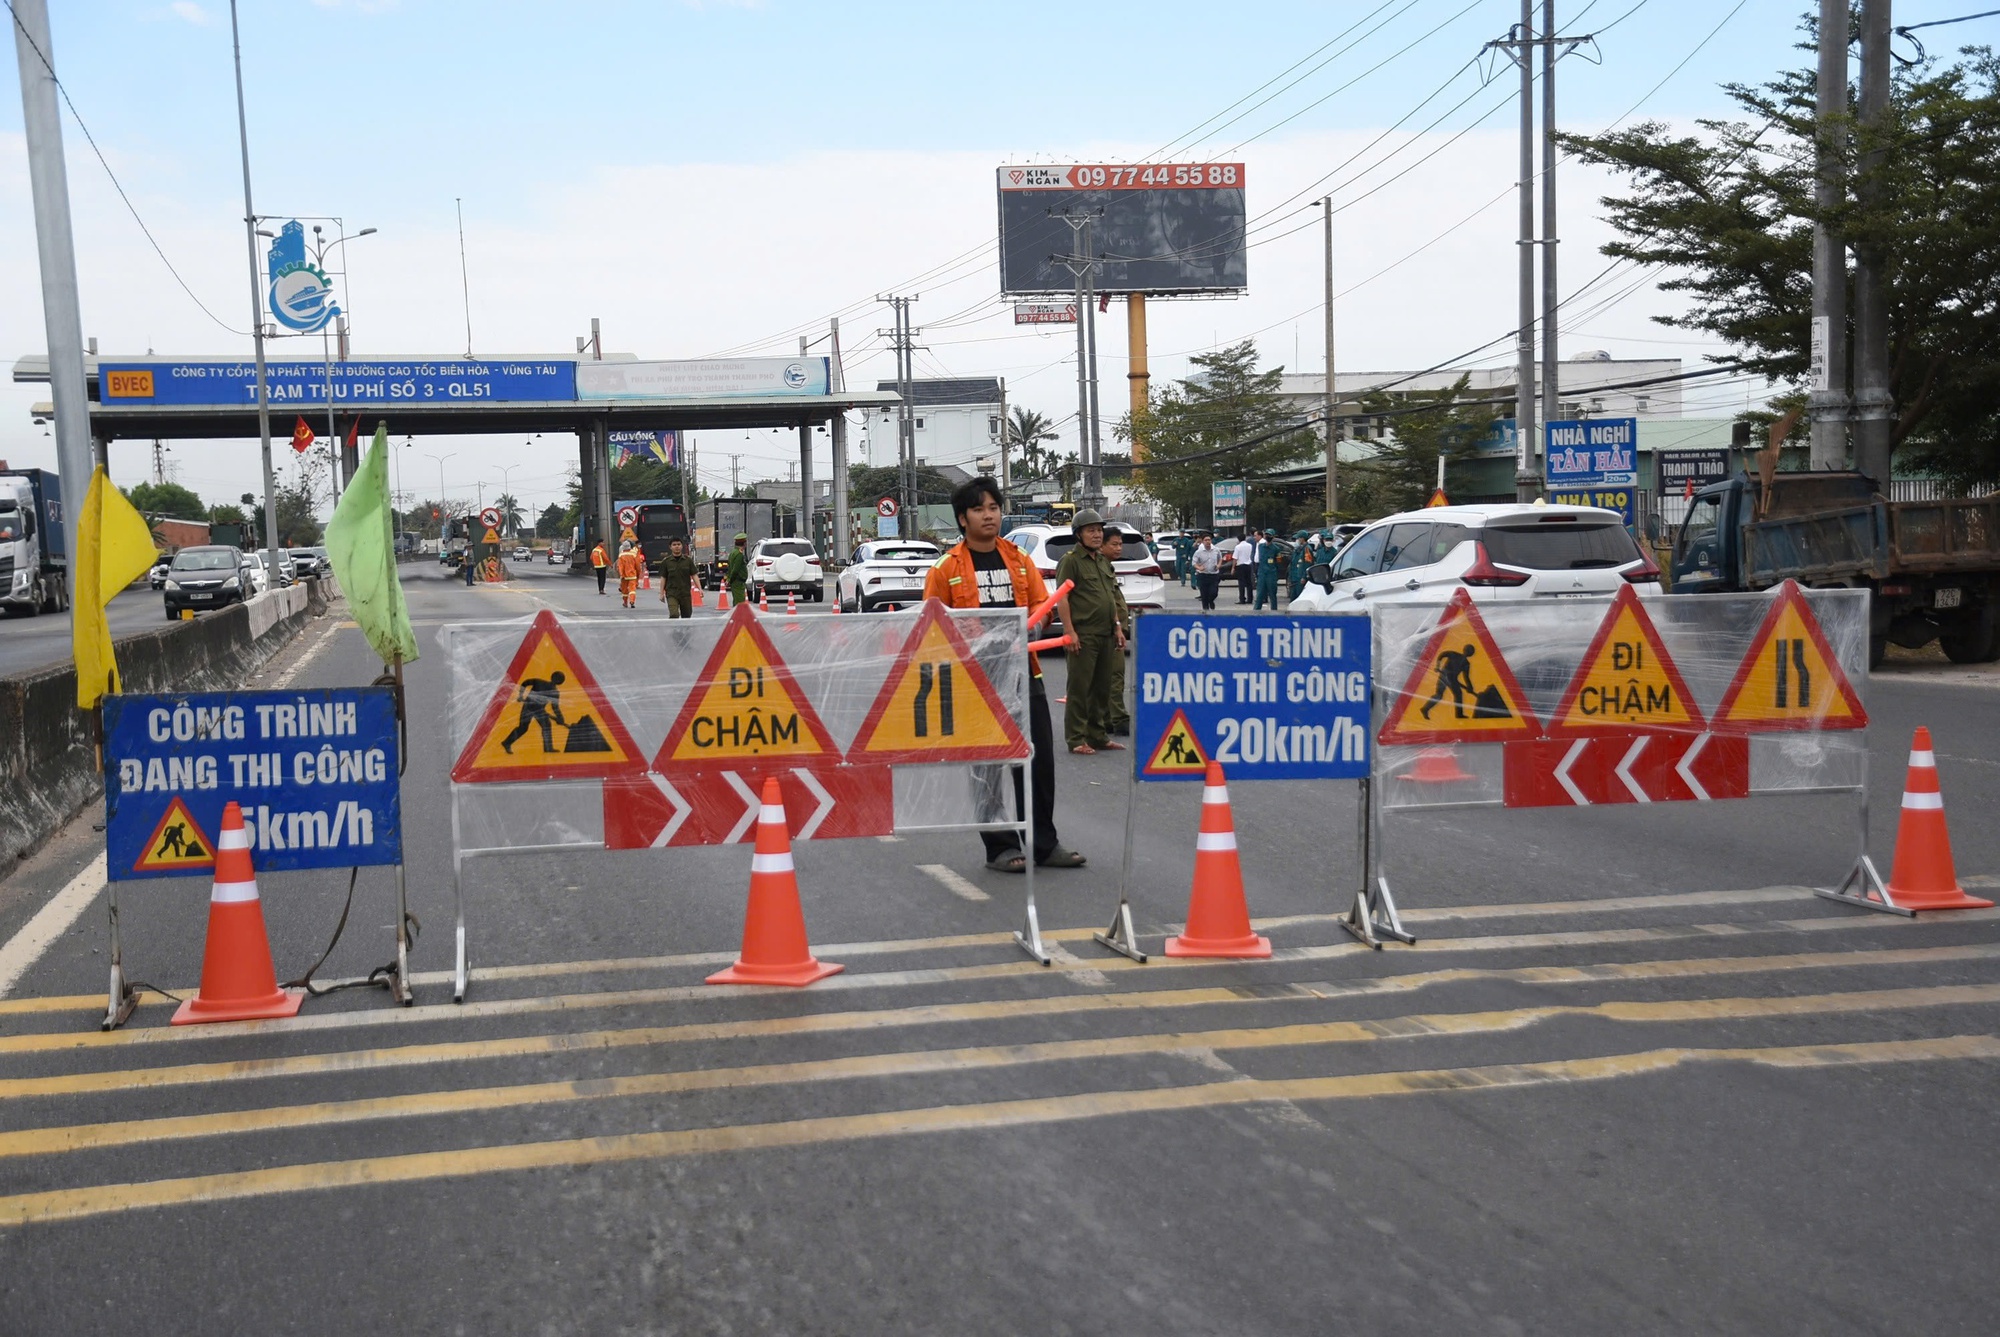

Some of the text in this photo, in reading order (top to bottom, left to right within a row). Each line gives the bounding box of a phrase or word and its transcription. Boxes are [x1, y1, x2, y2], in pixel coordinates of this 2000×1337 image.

[1077, 167, 1106, 186] 09
[1175, 166, 1203, 185] 55
[1208, 166, 1236, 185] 88
[111, 376, 150, 392] BVEC
[173, 366, 206, 377] CÔNG
[209, 367, 224, 377] TY
[226, 363, 243, 377] CỔ
[244, 366, 276, 377] PHN
[277, 364, 307, 377] PHÁT
[347, 363, 385, 376] ĐƯỜNG
[389, 366, 411, 376] CAO
[415, 363, 437, 376] TỐC
[467, 363, 490, 376] HÒA
[502, 364, 532, 375] VŨNG
[535, 364, 557, 375] TÀU
[308, 383, 347, 398] THU
[353, 379, 384, 397] PHÍ
[390, 378, 416, 398] SỐ
[424, 383, 434, 397] 3
[448, 382, 492, 398] QL51
[1551, 420, 1630, 446] NHÀ NGHỈ
[1549, 447, 1591, 473] TÂN
[1594, 443, 1631, 471] HẢI
[1662, 462, 1695, 476] THANH
[1556, 491, 1628, 510] NHÀ TRỌ
[1168, 621, 1342, 659] CÔNG TRÌNH
[1611, 642, 1642, 670] ĐI
[728, 666, 764, 699] ĐI
[1142, 665, 1365, 703] ĐANG THI CÔNG
[1580, 678, 1670, 721] CHẬM
[148, 697, 357, 741] CÔNG TRÌNH
[691, 707, 799, 754] CHẬM
[1215, 716, 1365, 764] 20km/h
[119, 744, 386, 792] ĐANG THI CÔNG
